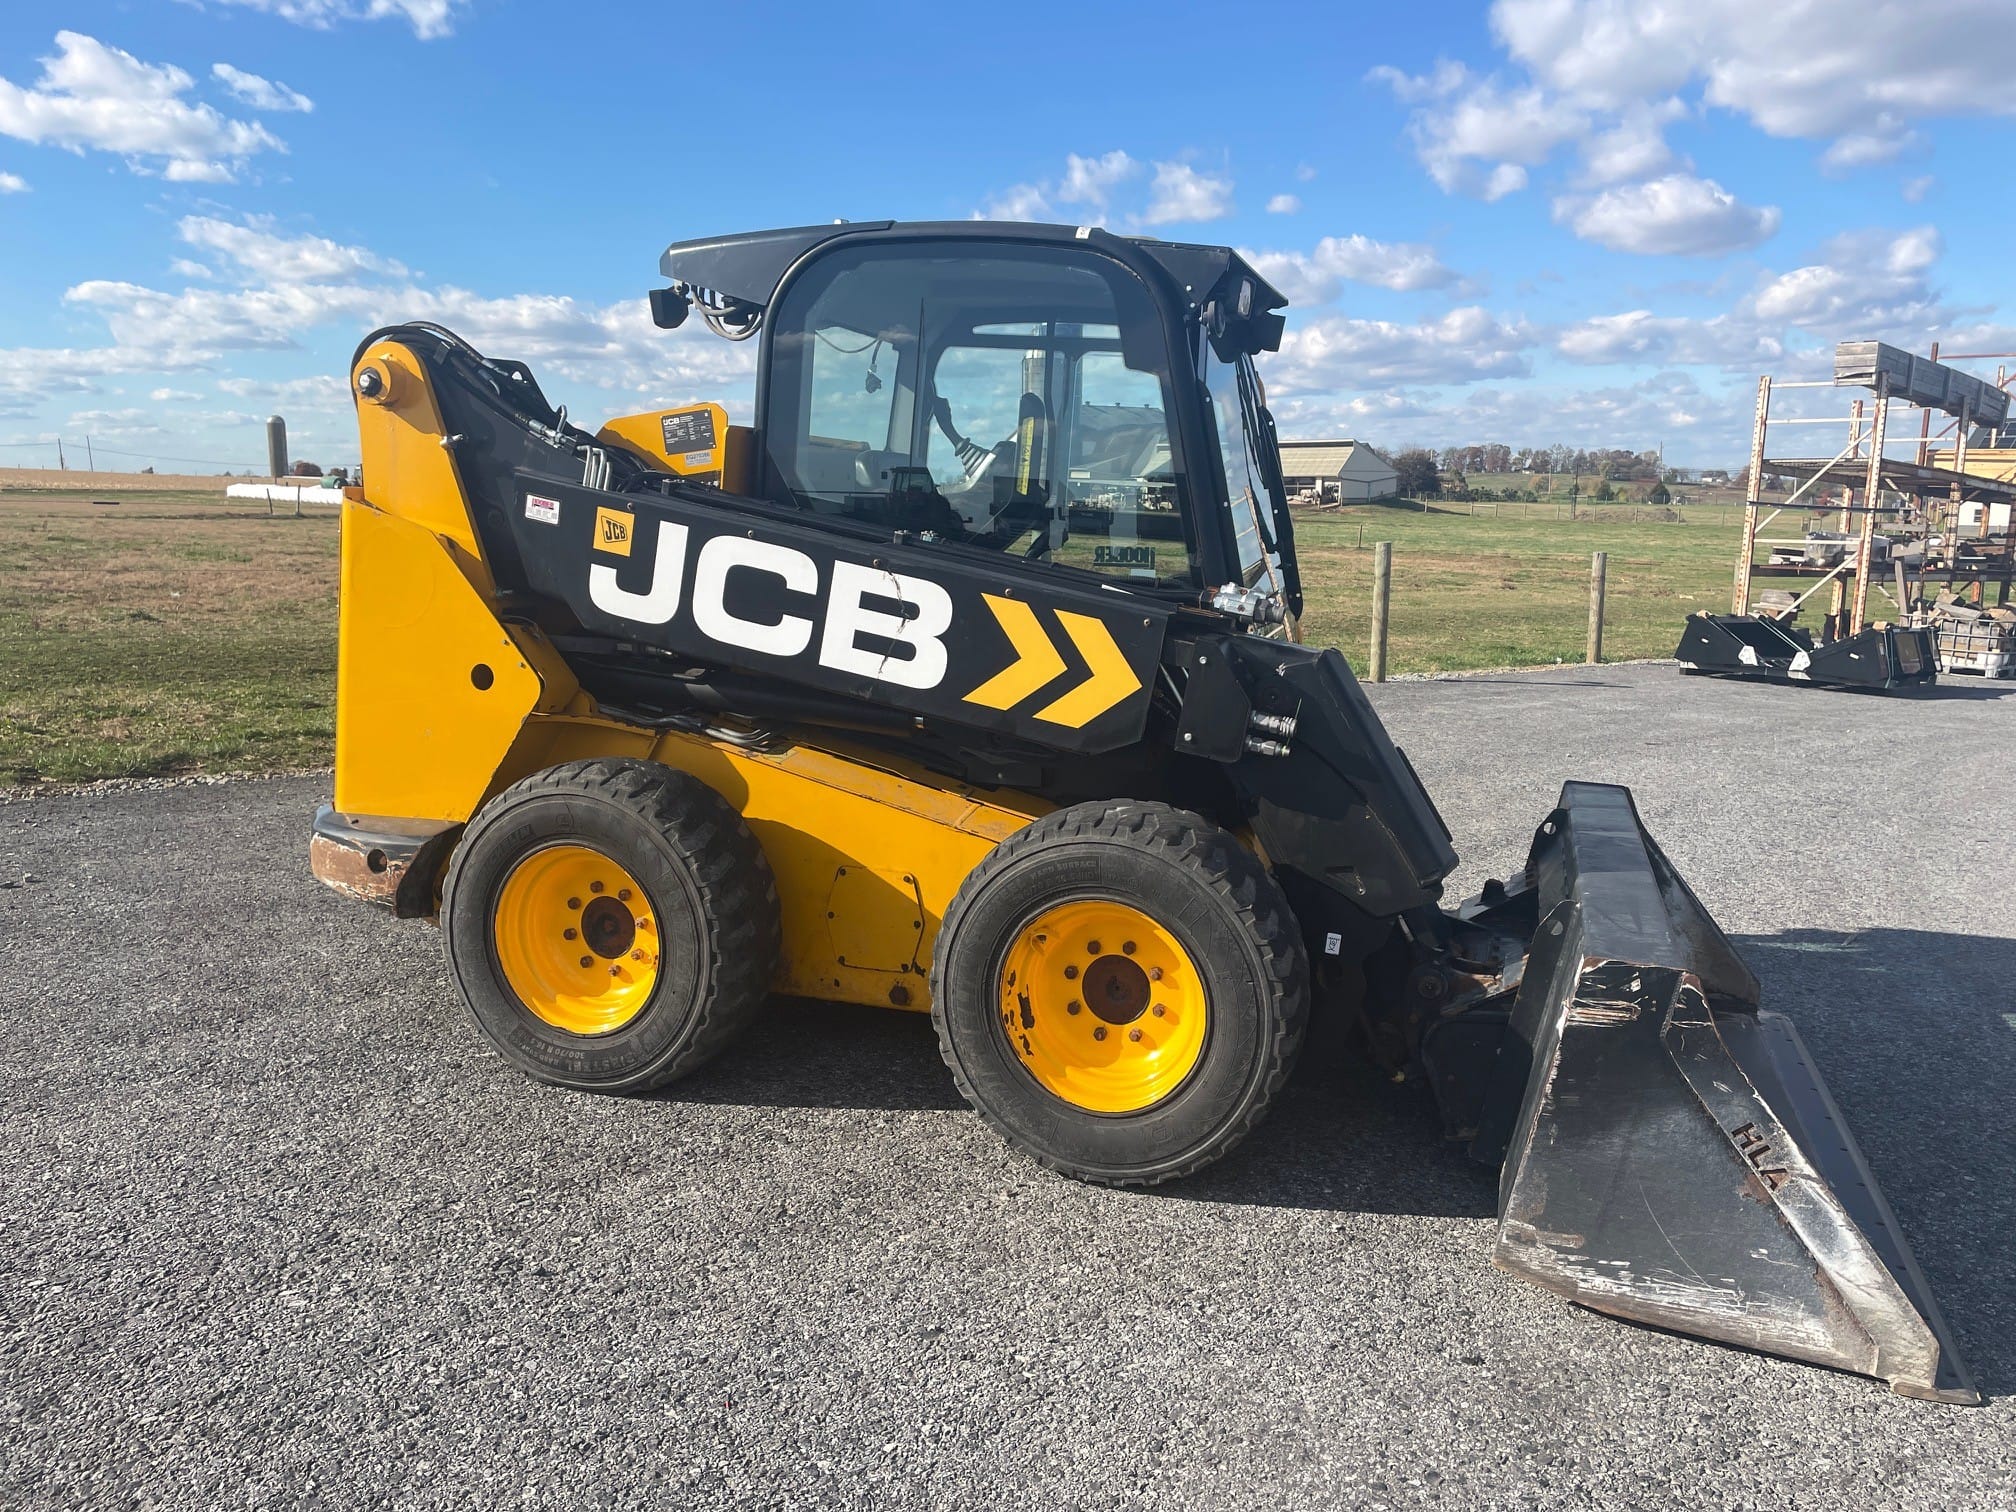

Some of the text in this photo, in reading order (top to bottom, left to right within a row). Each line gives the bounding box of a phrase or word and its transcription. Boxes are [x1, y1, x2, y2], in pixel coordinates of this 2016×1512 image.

[662, 417, 680, 426] JCB
[605, 519, 626, 541] JCB
[588, 520, 953, 690] JCB
[1731, 1122, 1788, 1191] HLA
